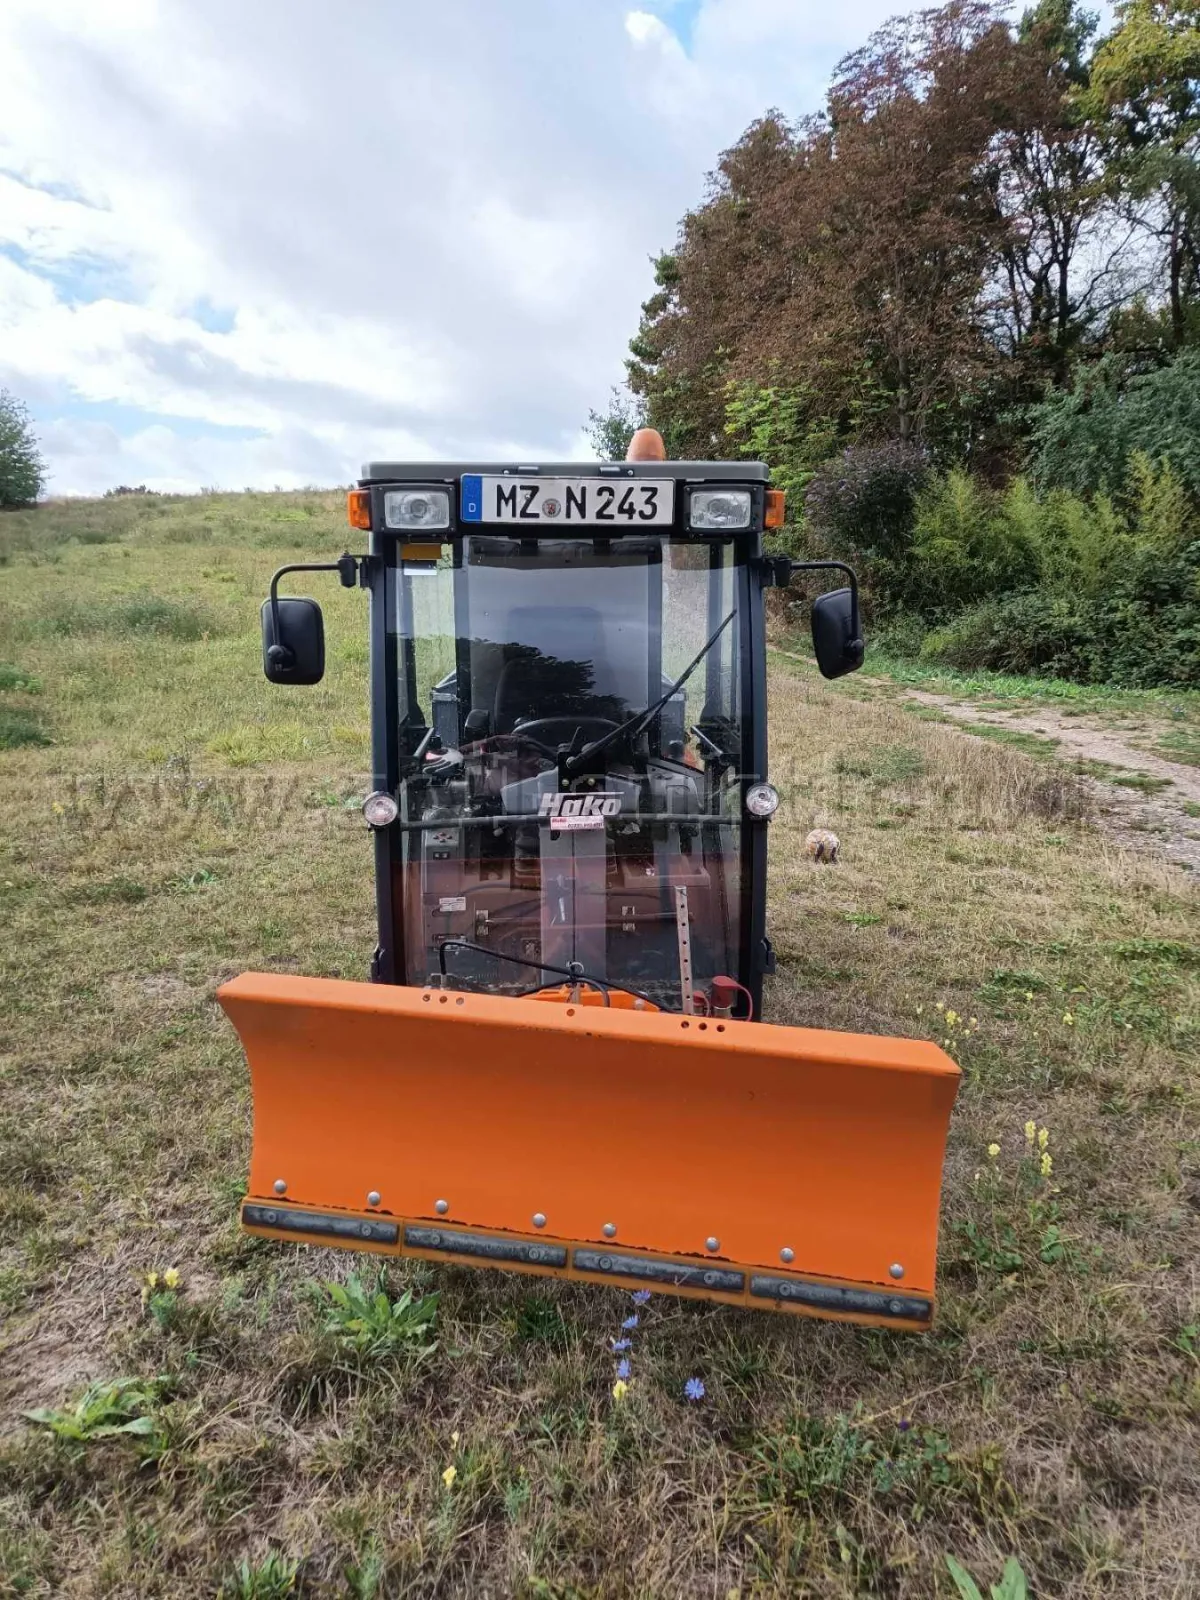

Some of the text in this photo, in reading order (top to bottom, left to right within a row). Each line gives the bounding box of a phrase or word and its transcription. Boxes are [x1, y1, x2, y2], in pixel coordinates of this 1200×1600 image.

[468, 502, 477, 513] D
[496, 484, 540, 519] MZ
[595, 486, 659, 521] 243
[537, 791, 624, 817] Hako
